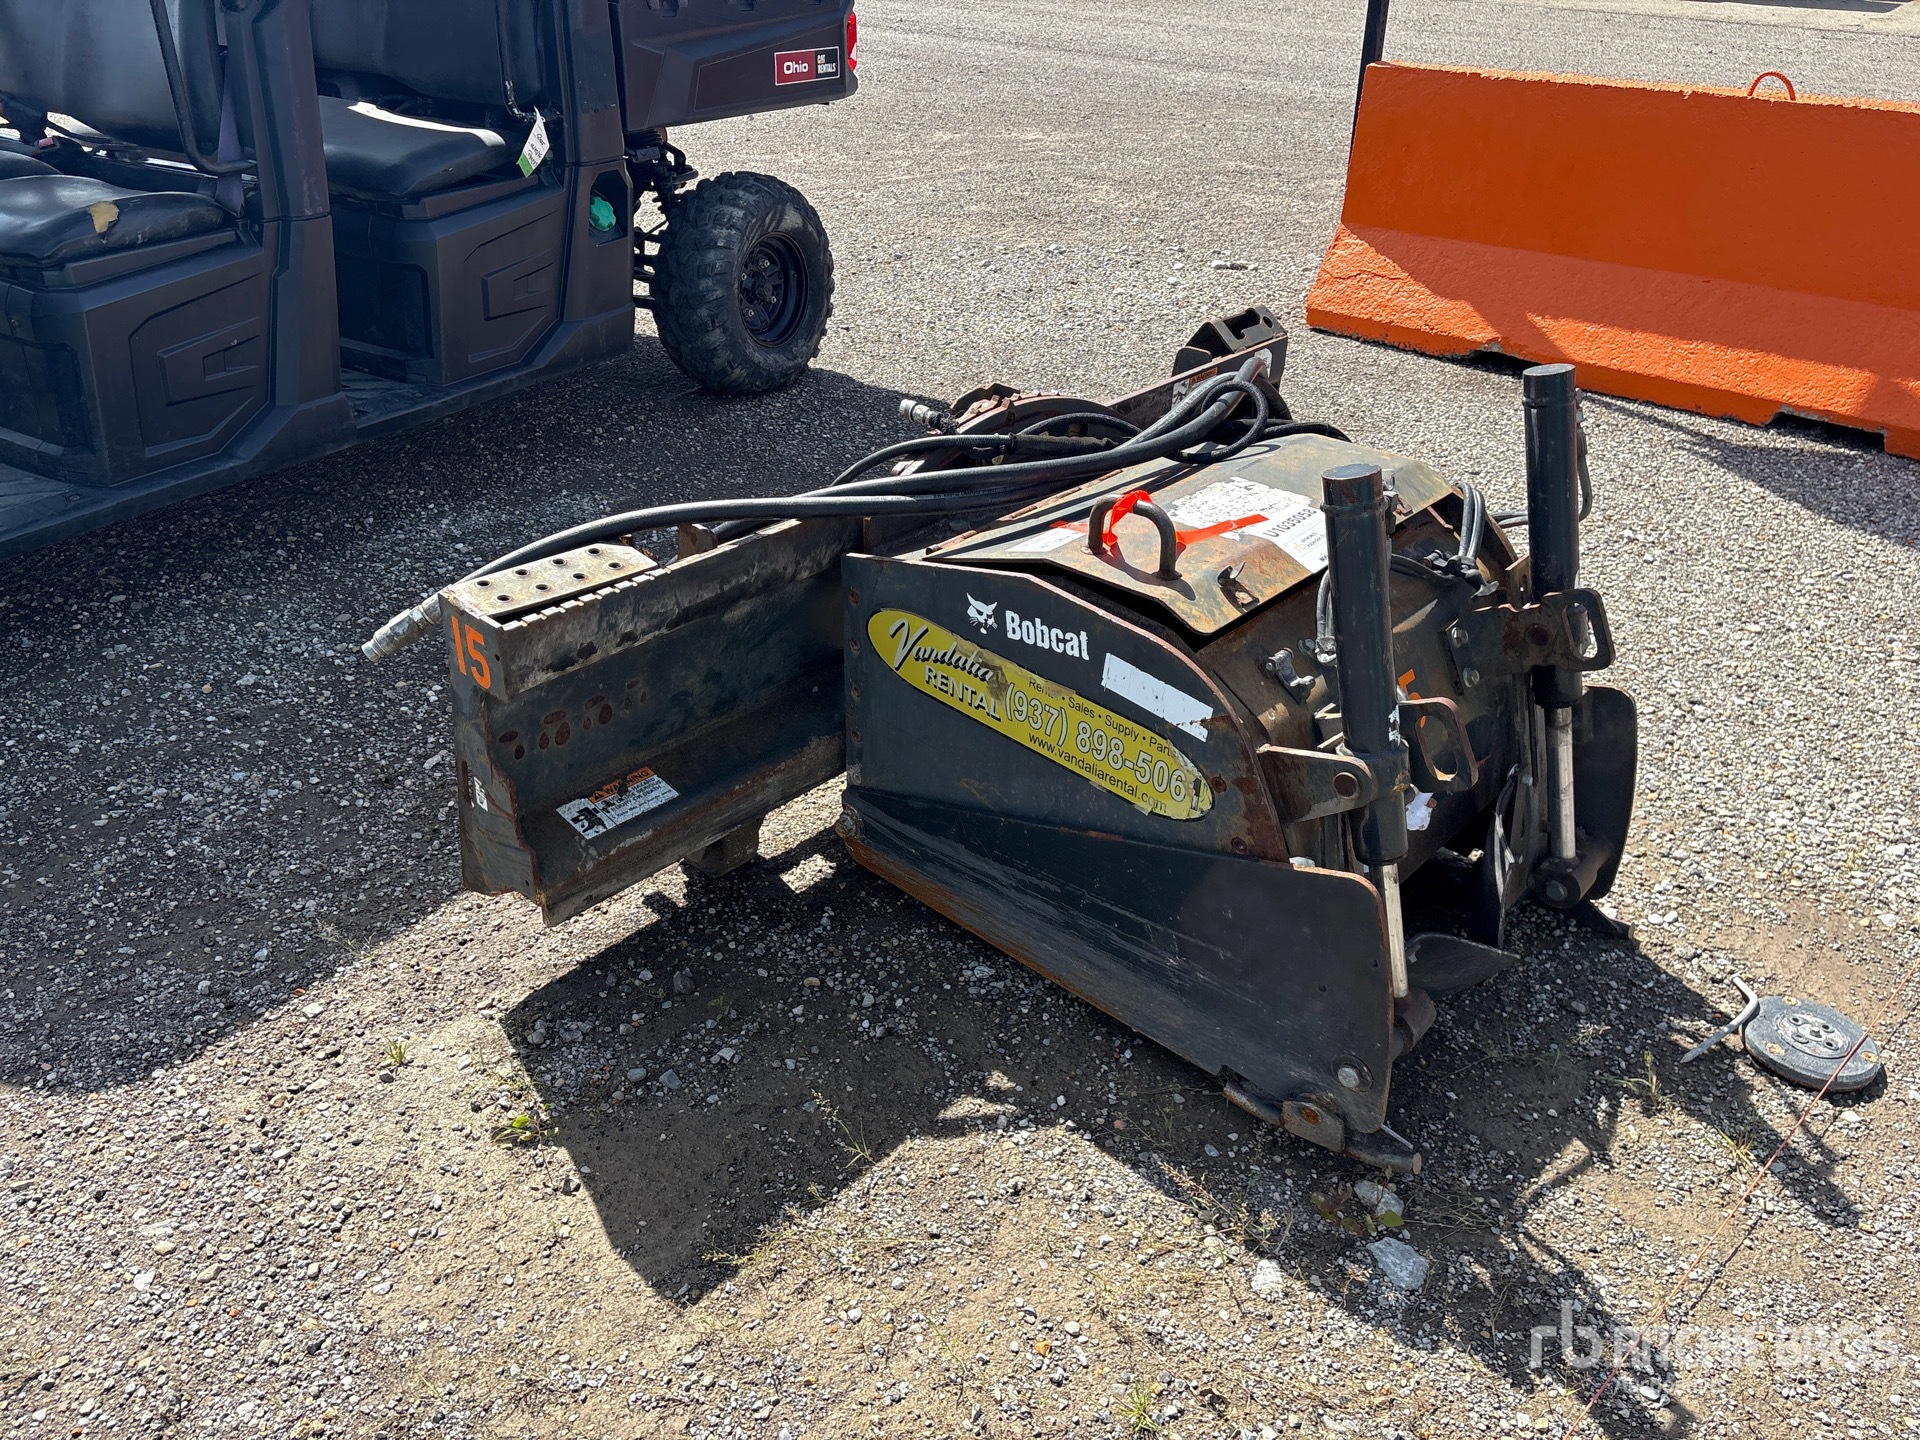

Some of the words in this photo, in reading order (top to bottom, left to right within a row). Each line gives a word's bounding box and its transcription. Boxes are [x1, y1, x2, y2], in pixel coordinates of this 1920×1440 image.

[783, 60, 809, 75] Ohio
[1263, 508, 1317, 538] U1035058
[451, 615, 491, 690] 15
[889, 617, 995, 682] Vandalia
[1005, 610, 1090, 661] Bobcat
[925, 664, 1002, 722] RENTAL
[1005, 681, 1068, 748] (937)
[1068, 696, 1096, 719] Sales
[1105, 714, 1140, 742] Supply
[604, 770, 650, 795] WANING
[1028, 732, 1168, 814] www.vandaliarental.com
